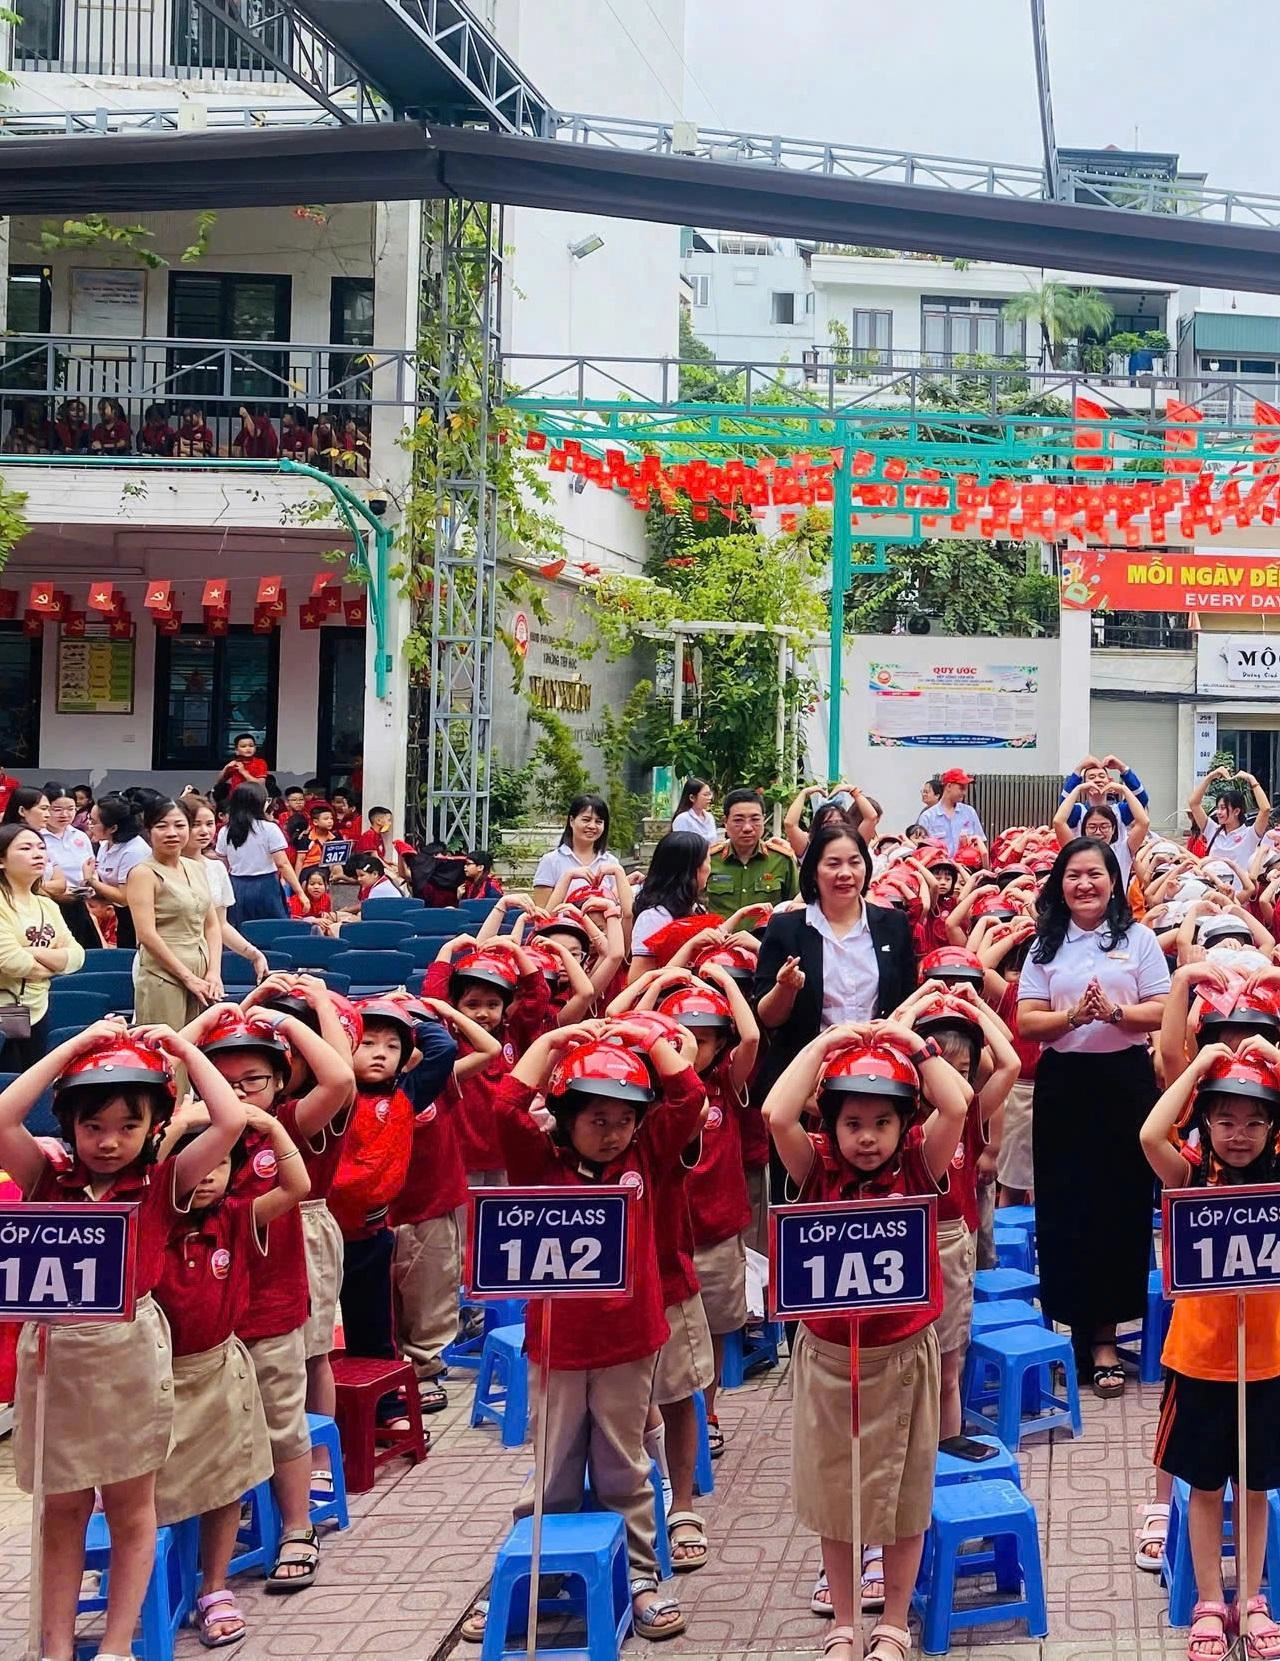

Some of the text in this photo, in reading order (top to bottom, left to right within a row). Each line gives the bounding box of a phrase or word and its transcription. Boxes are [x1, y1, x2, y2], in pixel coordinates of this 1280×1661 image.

[1127, 556, 1173, 585] MỖI
[1181, 562, 1244, 588] NGÀY
[1185, 594, 1245, 607] EVERY
[933, 666, 953, 675] QUY
[326, 851, 345, 863] 3A7
[498, 1205, 606, 1227] LỚP/CLASS
[0, 1221, 106, 1244] ỚP/CLASS
[799, 1220, 908, 1244] LỚP/CLASS
[499, 1237, 602, 1281] 1A2
[0, 1257, 97, 1302] 1A1
[802, 1250, 905, 1299] 1A3
